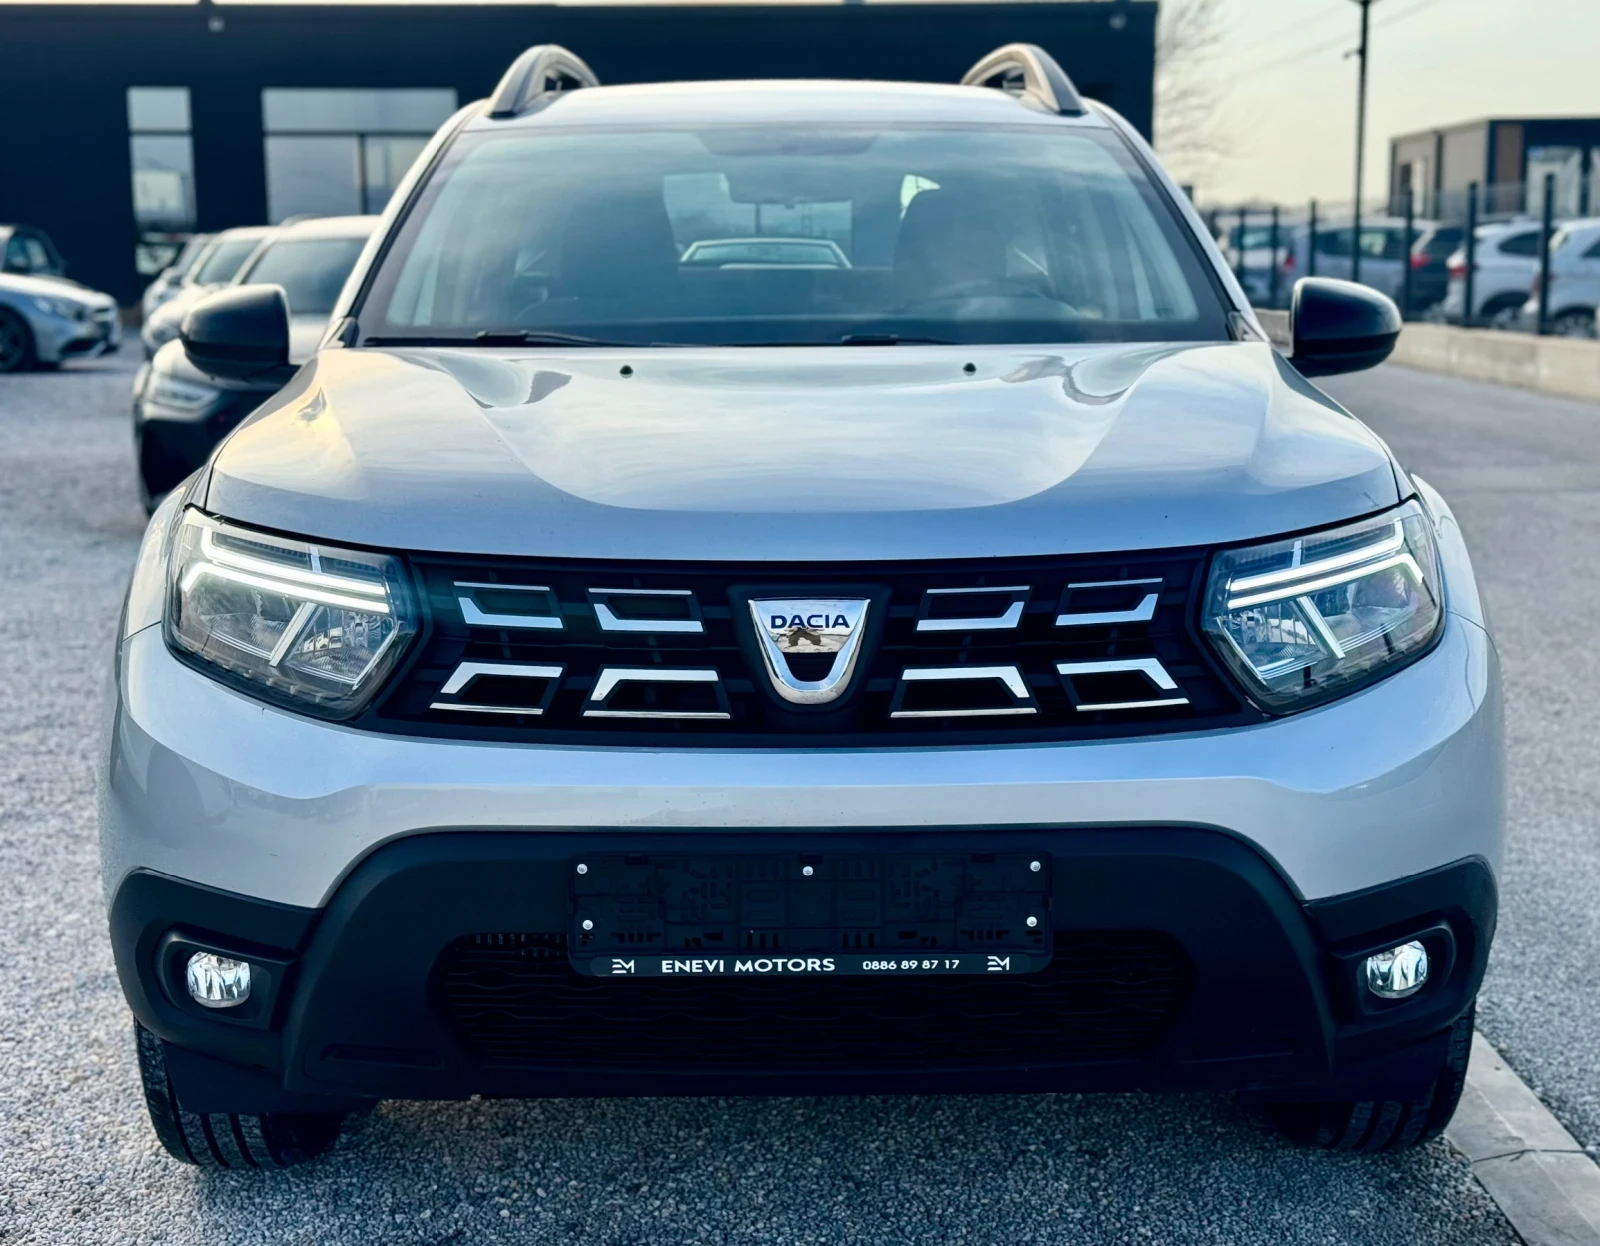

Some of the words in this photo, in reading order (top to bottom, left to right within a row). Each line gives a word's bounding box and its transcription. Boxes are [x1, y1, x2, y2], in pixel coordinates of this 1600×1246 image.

[770, 614, 850, 629] DACIA
[661, 959, 725, 973] ENEVI
[734, 958, 836, 973] MOTORS
[862, 960, 897, 971] 0886
[900, 960, 918, 970] 89
[922, 959, 939, 969] 87
[944, 959, 960, 969] 17
